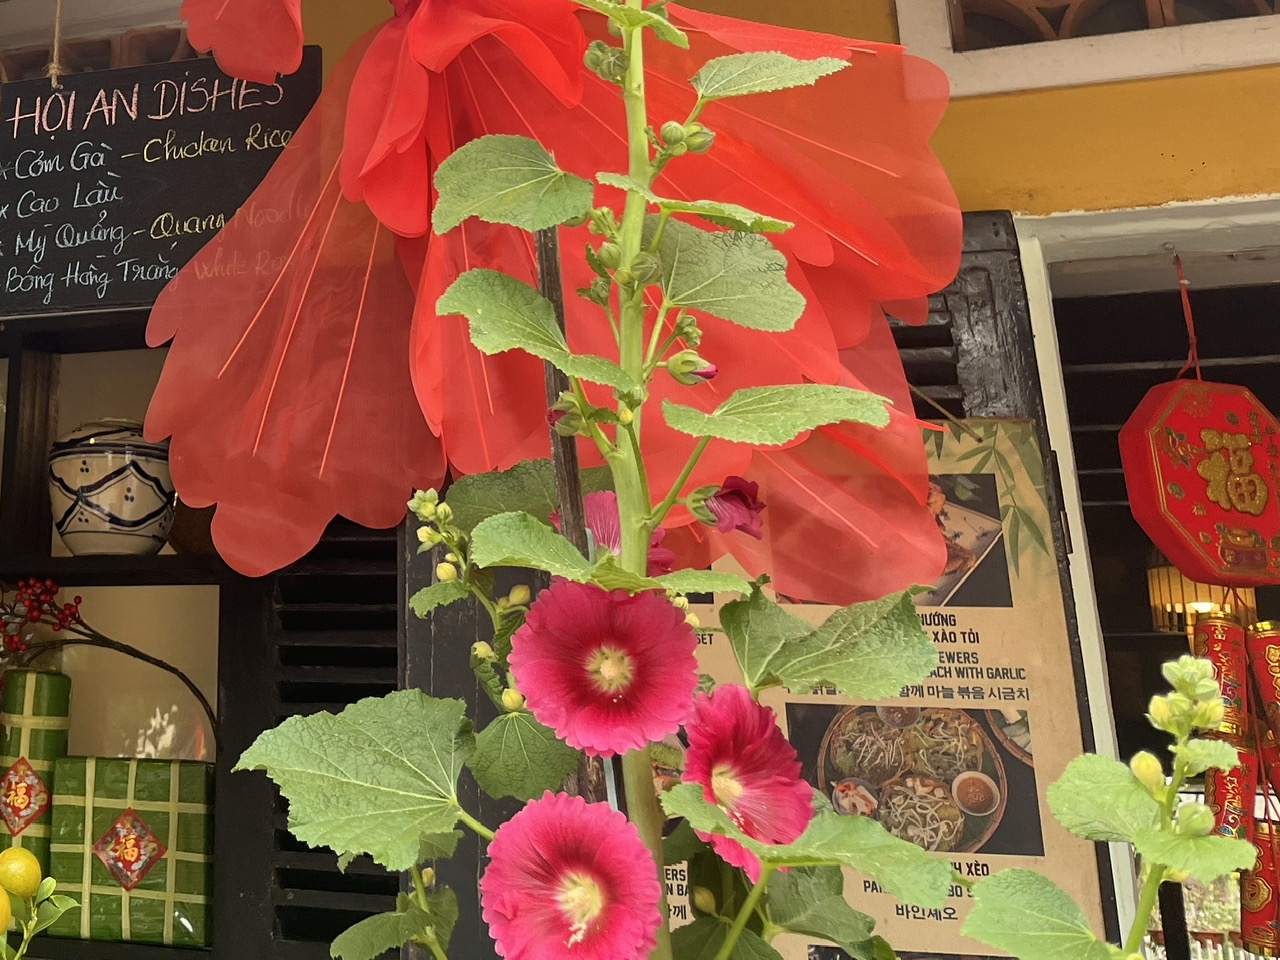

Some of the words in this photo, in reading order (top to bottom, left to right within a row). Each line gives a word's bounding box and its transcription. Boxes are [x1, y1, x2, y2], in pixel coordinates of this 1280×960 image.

[83, 83, 140, 131] AN
[70, 141, 113, 171] Gà
[143, 129, 237, 163] Chicken
[245, 122, 295, 151] Rice
[16, 189, 61, 219] Cao
[55, 209, 130, 255] Quảng
[150, 212, 226, 242] Quang
[5, 265, 55, 305] Bông
[932, 628, 958, 644] XÀO
[960, 628, 980, 644] TỎI
[938, 651, 979, 665] EWERS
[955, 666, 984, 680] WITH
[986, 667, 1027, 681] GARLIC
[927, 685, 955, 699] 마늘
[957, 685, 986, 700] 볶음
[988, 687, 1031, 701] 시금치
[6, 781, 30, 809] 福
[115, 833, 139, 863] 福
[965, 859, 990, 877] XÈO
